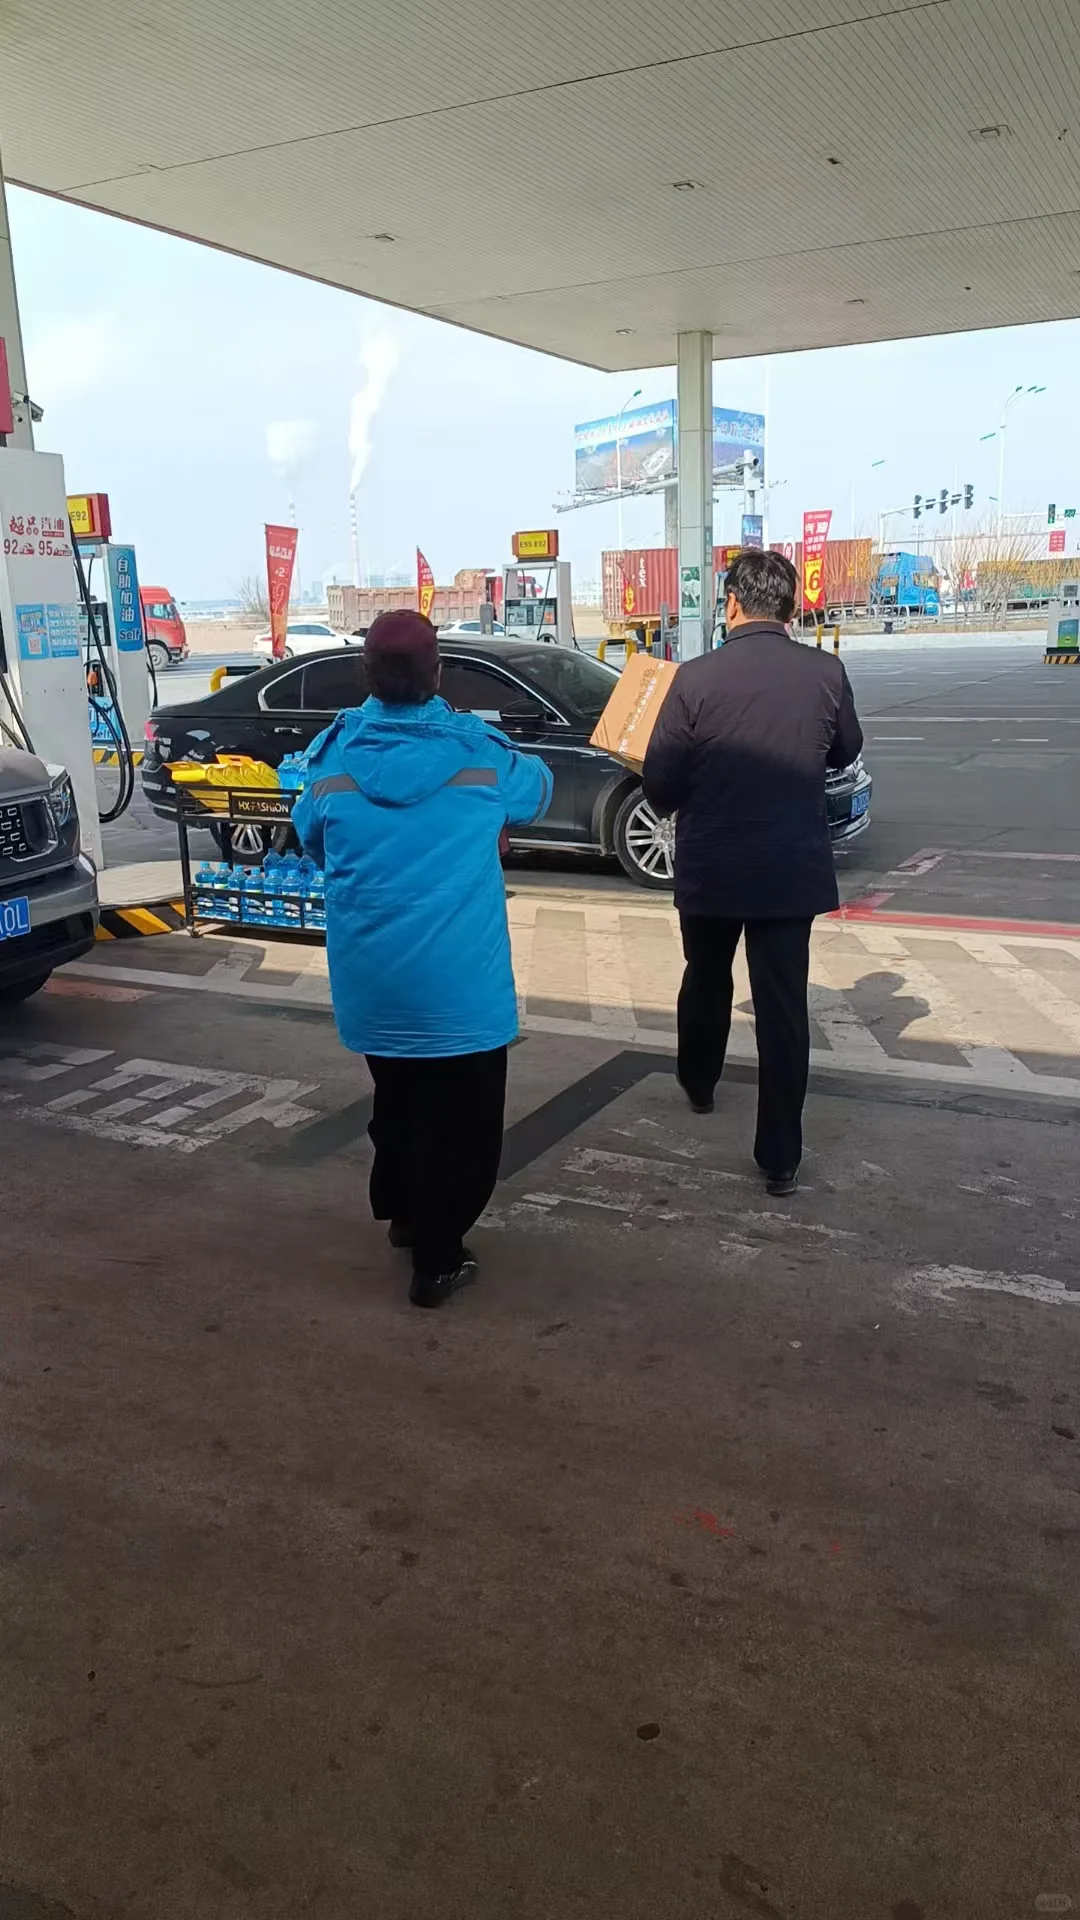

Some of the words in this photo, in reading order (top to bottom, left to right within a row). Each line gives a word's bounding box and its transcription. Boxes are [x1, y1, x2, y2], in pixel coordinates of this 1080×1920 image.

[70, 511, 87, 521] E92
[3, 539, 19, 555] 92
[38, 541, 53, 556] 95
[638, 557, 648, 588] tex
[809, 569, 820, 591] 6
[117, 557, 135, 622] 自助加油
[119, 628, 141, 641] Self
